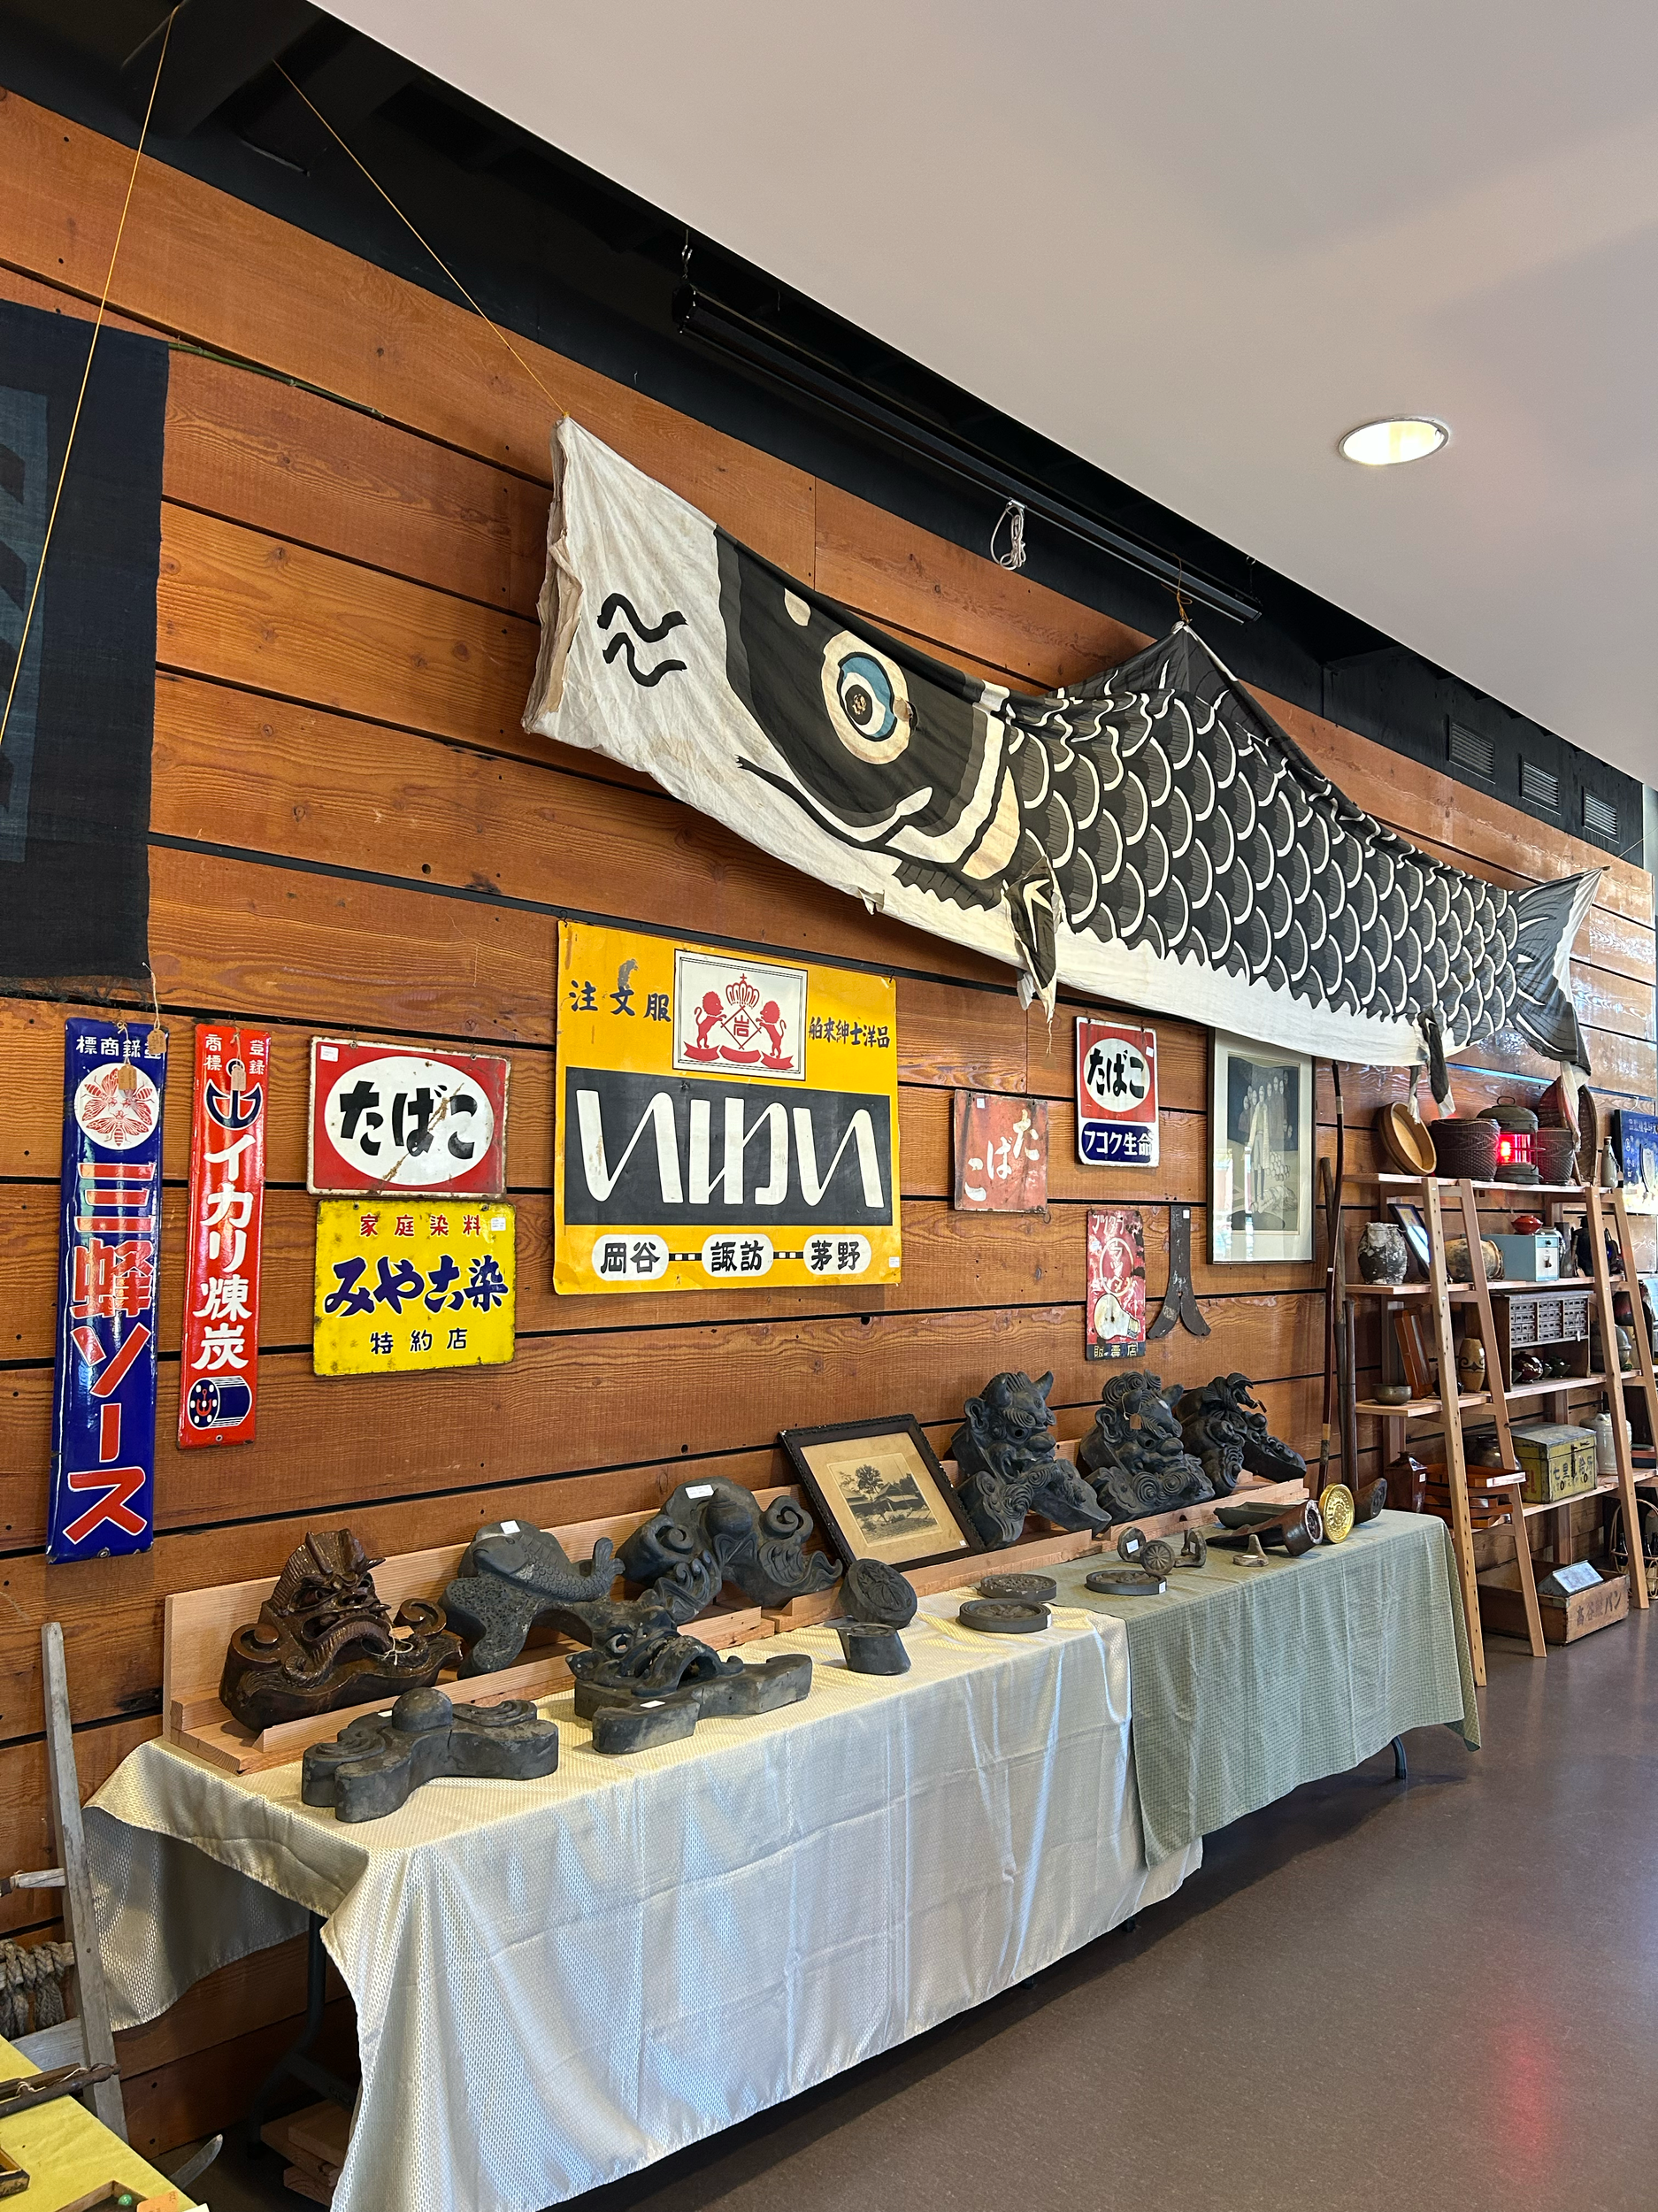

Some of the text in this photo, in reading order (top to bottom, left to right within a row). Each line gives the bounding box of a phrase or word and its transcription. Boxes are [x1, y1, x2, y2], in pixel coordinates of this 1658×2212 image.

[568, 979, 672, 1023] 注文服
[809, 1017, 890, 1048] 舶来紳士洋品
[1087, 1048, 1145, 1099] たばこ
[340, 1080, 478, 1160] たばこ
[964, 1109, 1040, 1202] たばこ
[1084, 1130, 1153, 1156] フコク生命
[359, 1214, 481, 1237] 家庭染料
[190, 1133, 256, 1371] イカリ煉炭
[601, 1240, 861, 1273] 岡谷 諏訪 茅野
[62, 1162, 156, 1545] 三蜂ソース
[370, 1327, 468, 1355] 特約店
